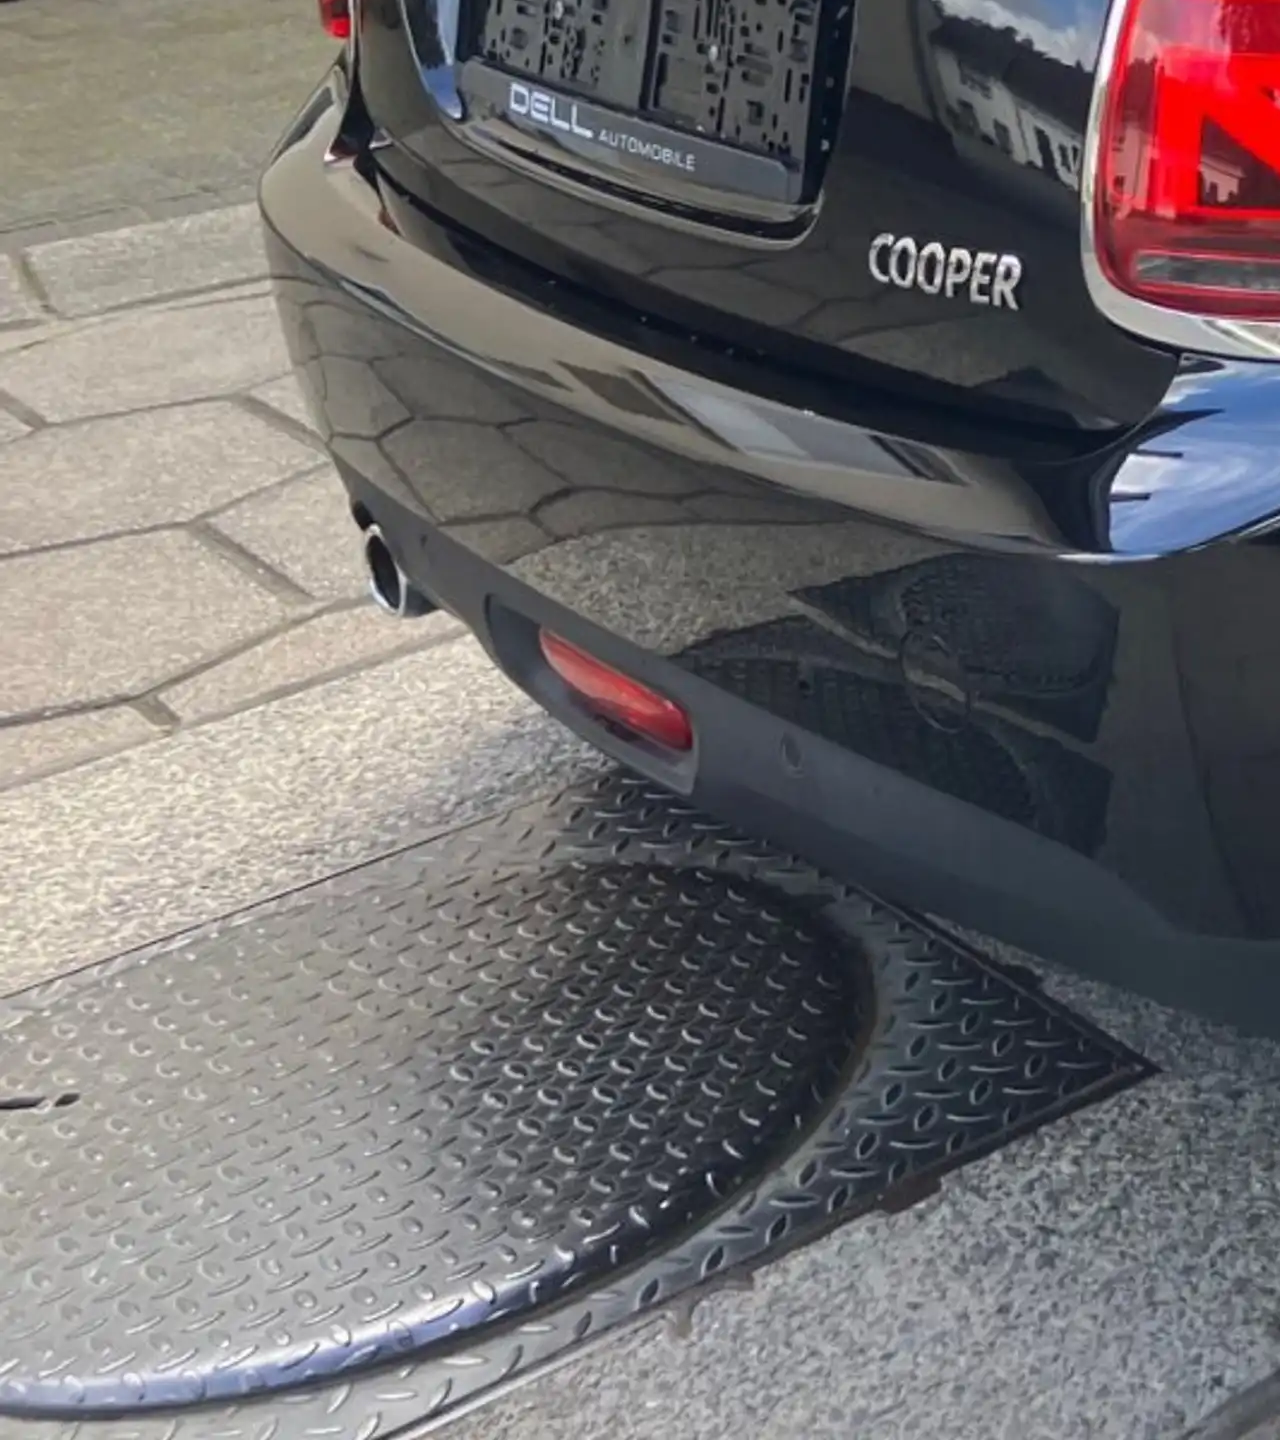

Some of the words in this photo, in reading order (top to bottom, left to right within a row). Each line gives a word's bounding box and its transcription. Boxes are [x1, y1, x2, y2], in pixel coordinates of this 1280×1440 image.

[508, 81, 594, 139] DELL
[598, 129, 696, 172] AUTOMOBILE
[868, 232, 1022, 311] COOPER
